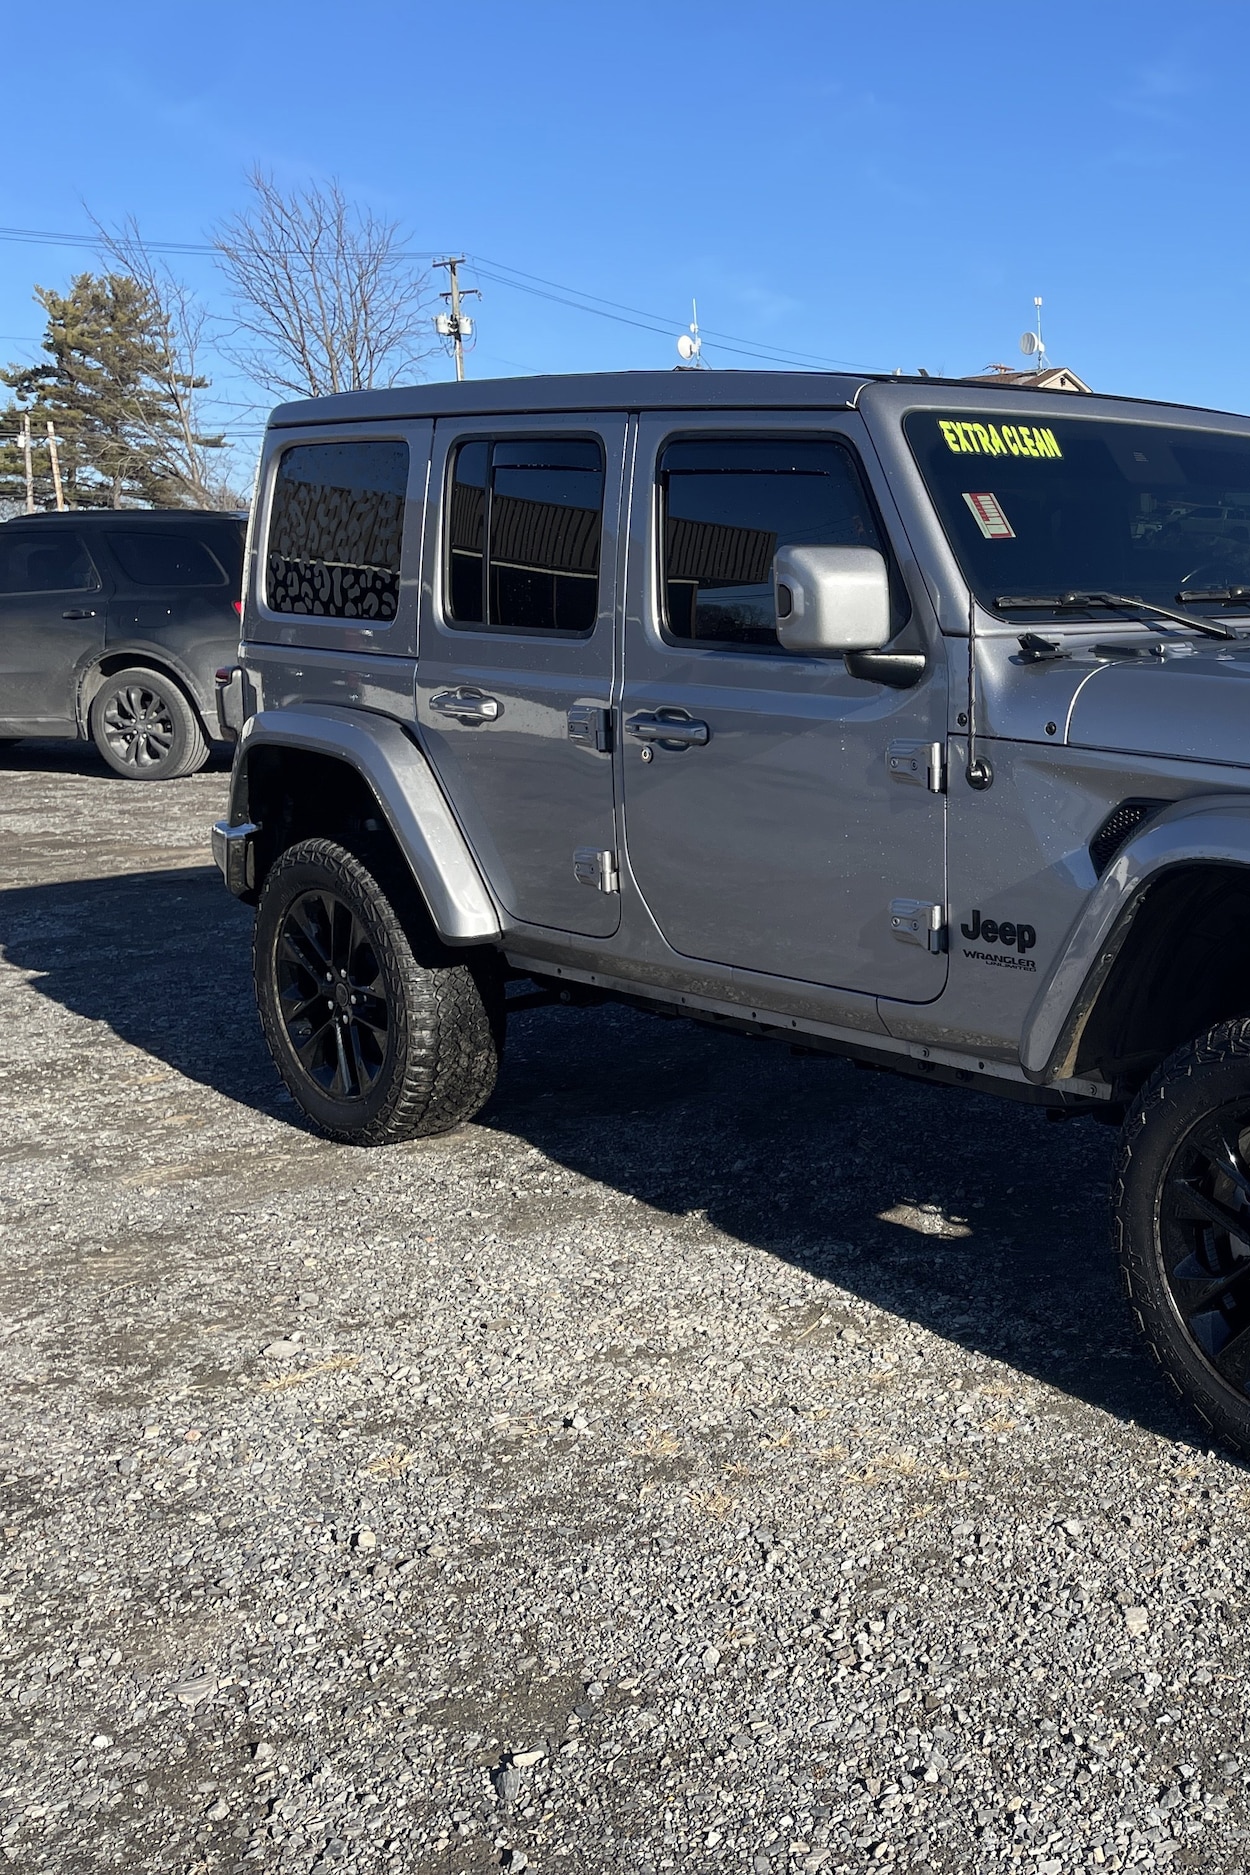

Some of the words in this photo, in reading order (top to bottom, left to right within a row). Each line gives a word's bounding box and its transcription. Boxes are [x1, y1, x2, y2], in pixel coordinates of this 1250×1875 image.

[938, 420, 1007, 456] EXTRA
[1001, 424, 1063, 458] CLEAN
[961, 909, 1036, 953] Jeep
[963, 949, 1036, 969] WRANGLER
[985, 960, 1037, 972] UNLIMITED
